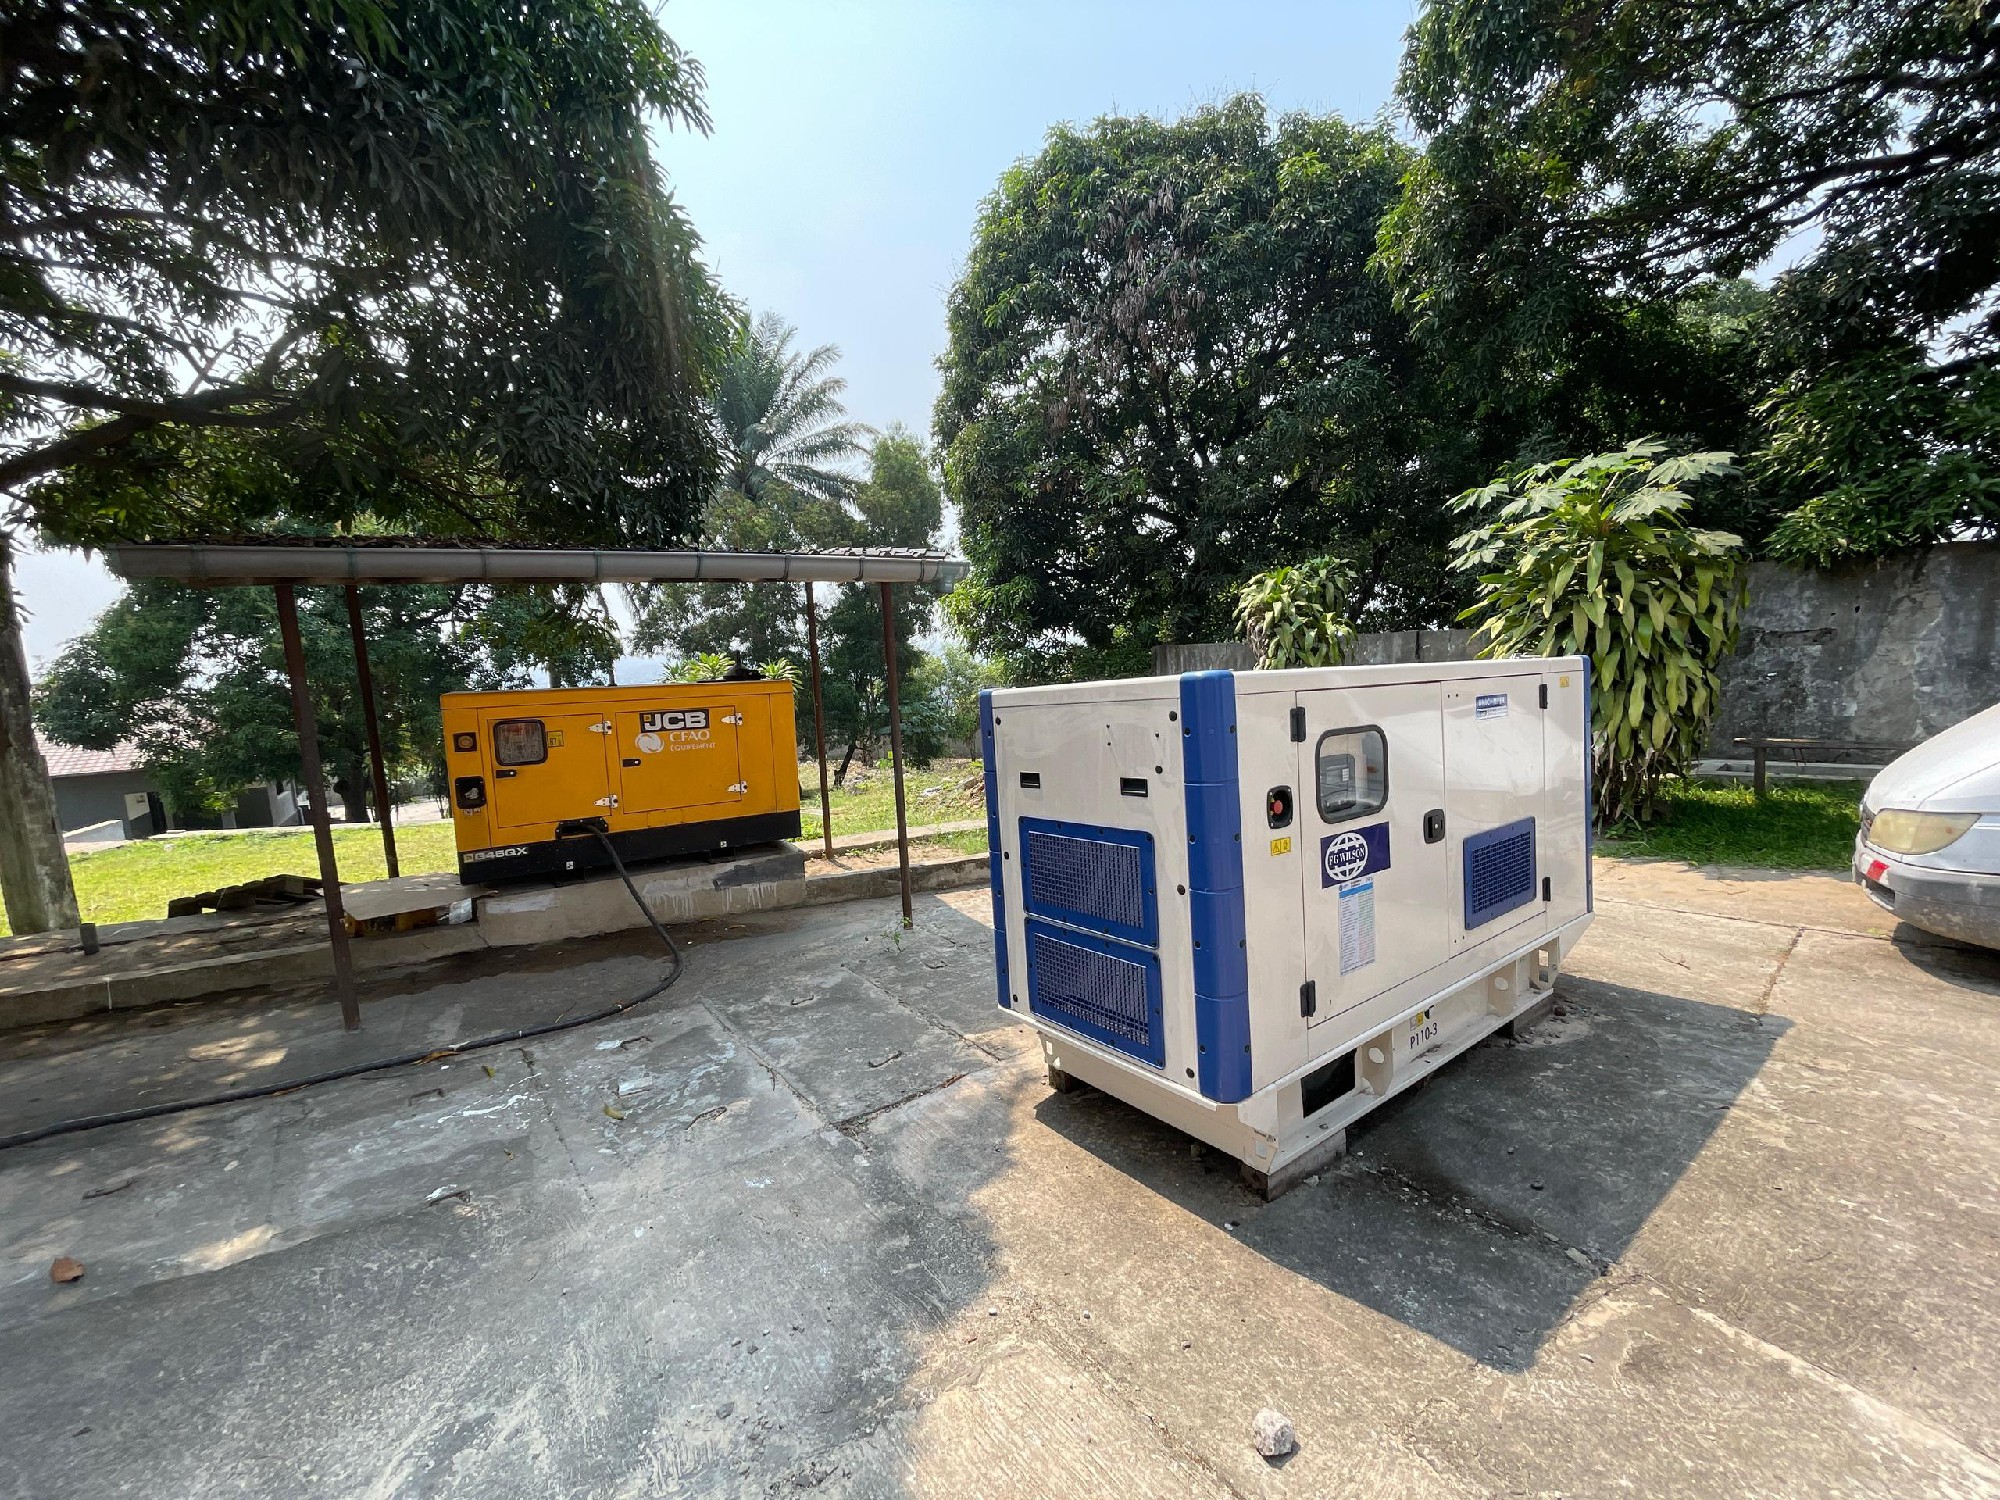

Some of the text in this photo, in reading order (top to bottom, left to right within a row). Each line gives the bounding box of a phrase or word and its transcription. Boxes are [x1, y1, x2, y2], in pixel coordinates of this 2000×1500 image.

[644, 711, 706, 731] JCB
[669, 730, 710, 742] CFAO
[1329, 847, 1365, 866] FG WILSON
[1410, 1022, 1438, 1049] P110-3
